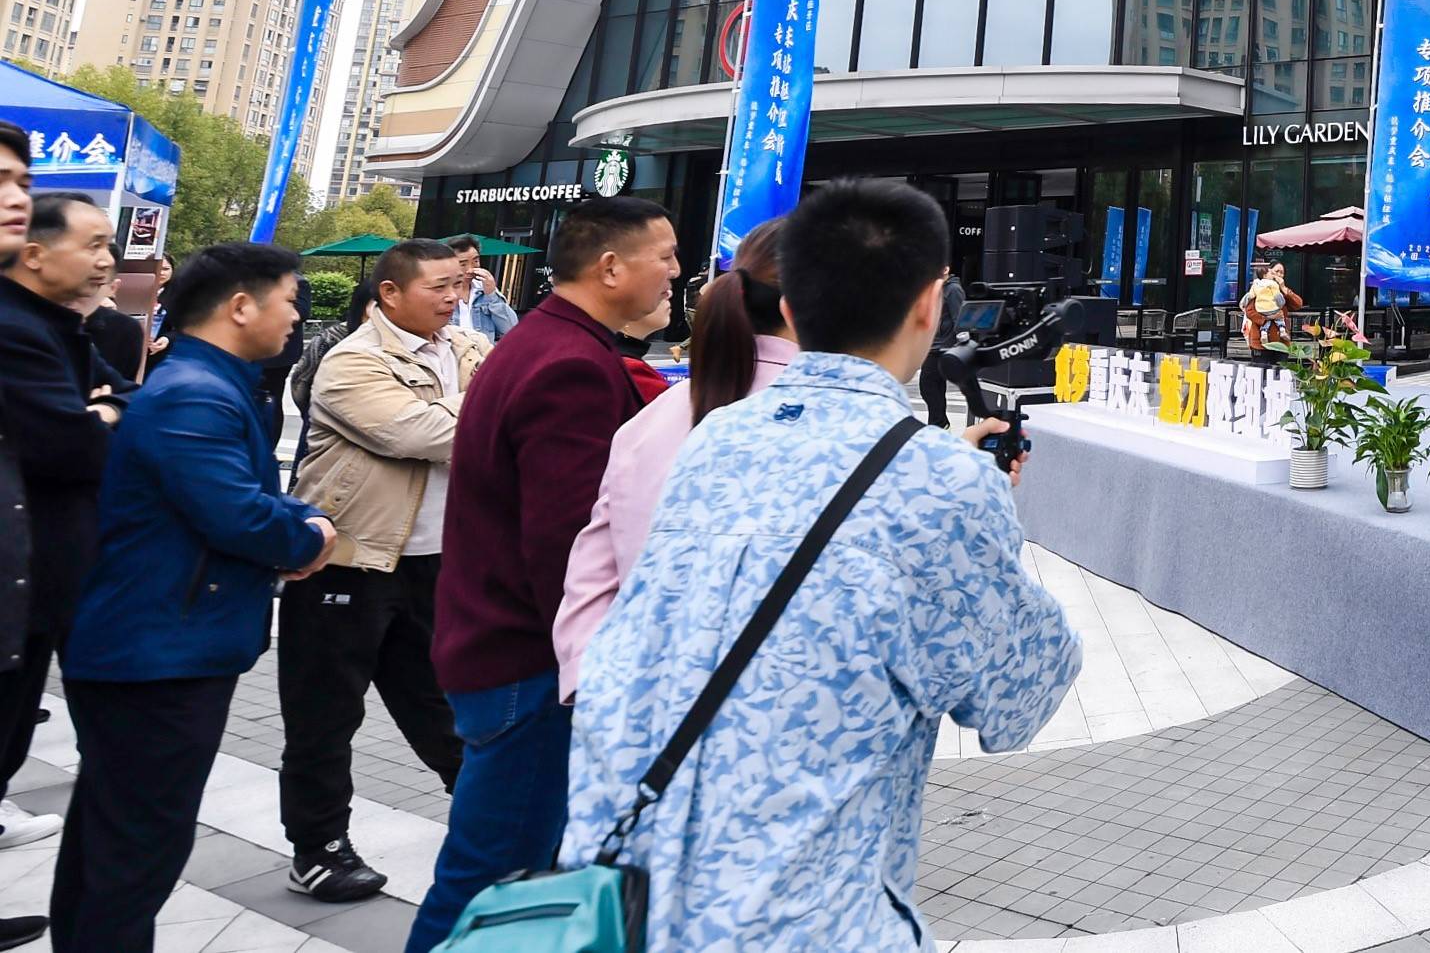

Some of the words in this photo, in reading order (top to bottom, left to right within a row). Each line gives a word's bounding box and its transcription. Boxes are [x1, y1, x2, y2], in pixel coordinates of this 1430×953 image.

[1242, 124, 1284, 146] LILY
[1284, 121, 1370, 144] GARDEN
[456, 186, 530, 204] STARBUCKS
[532, 184, 582, 201] COFFEE
[959, 226, 982, 236] COFF
[999, 334, 1038, 360] RONIN
